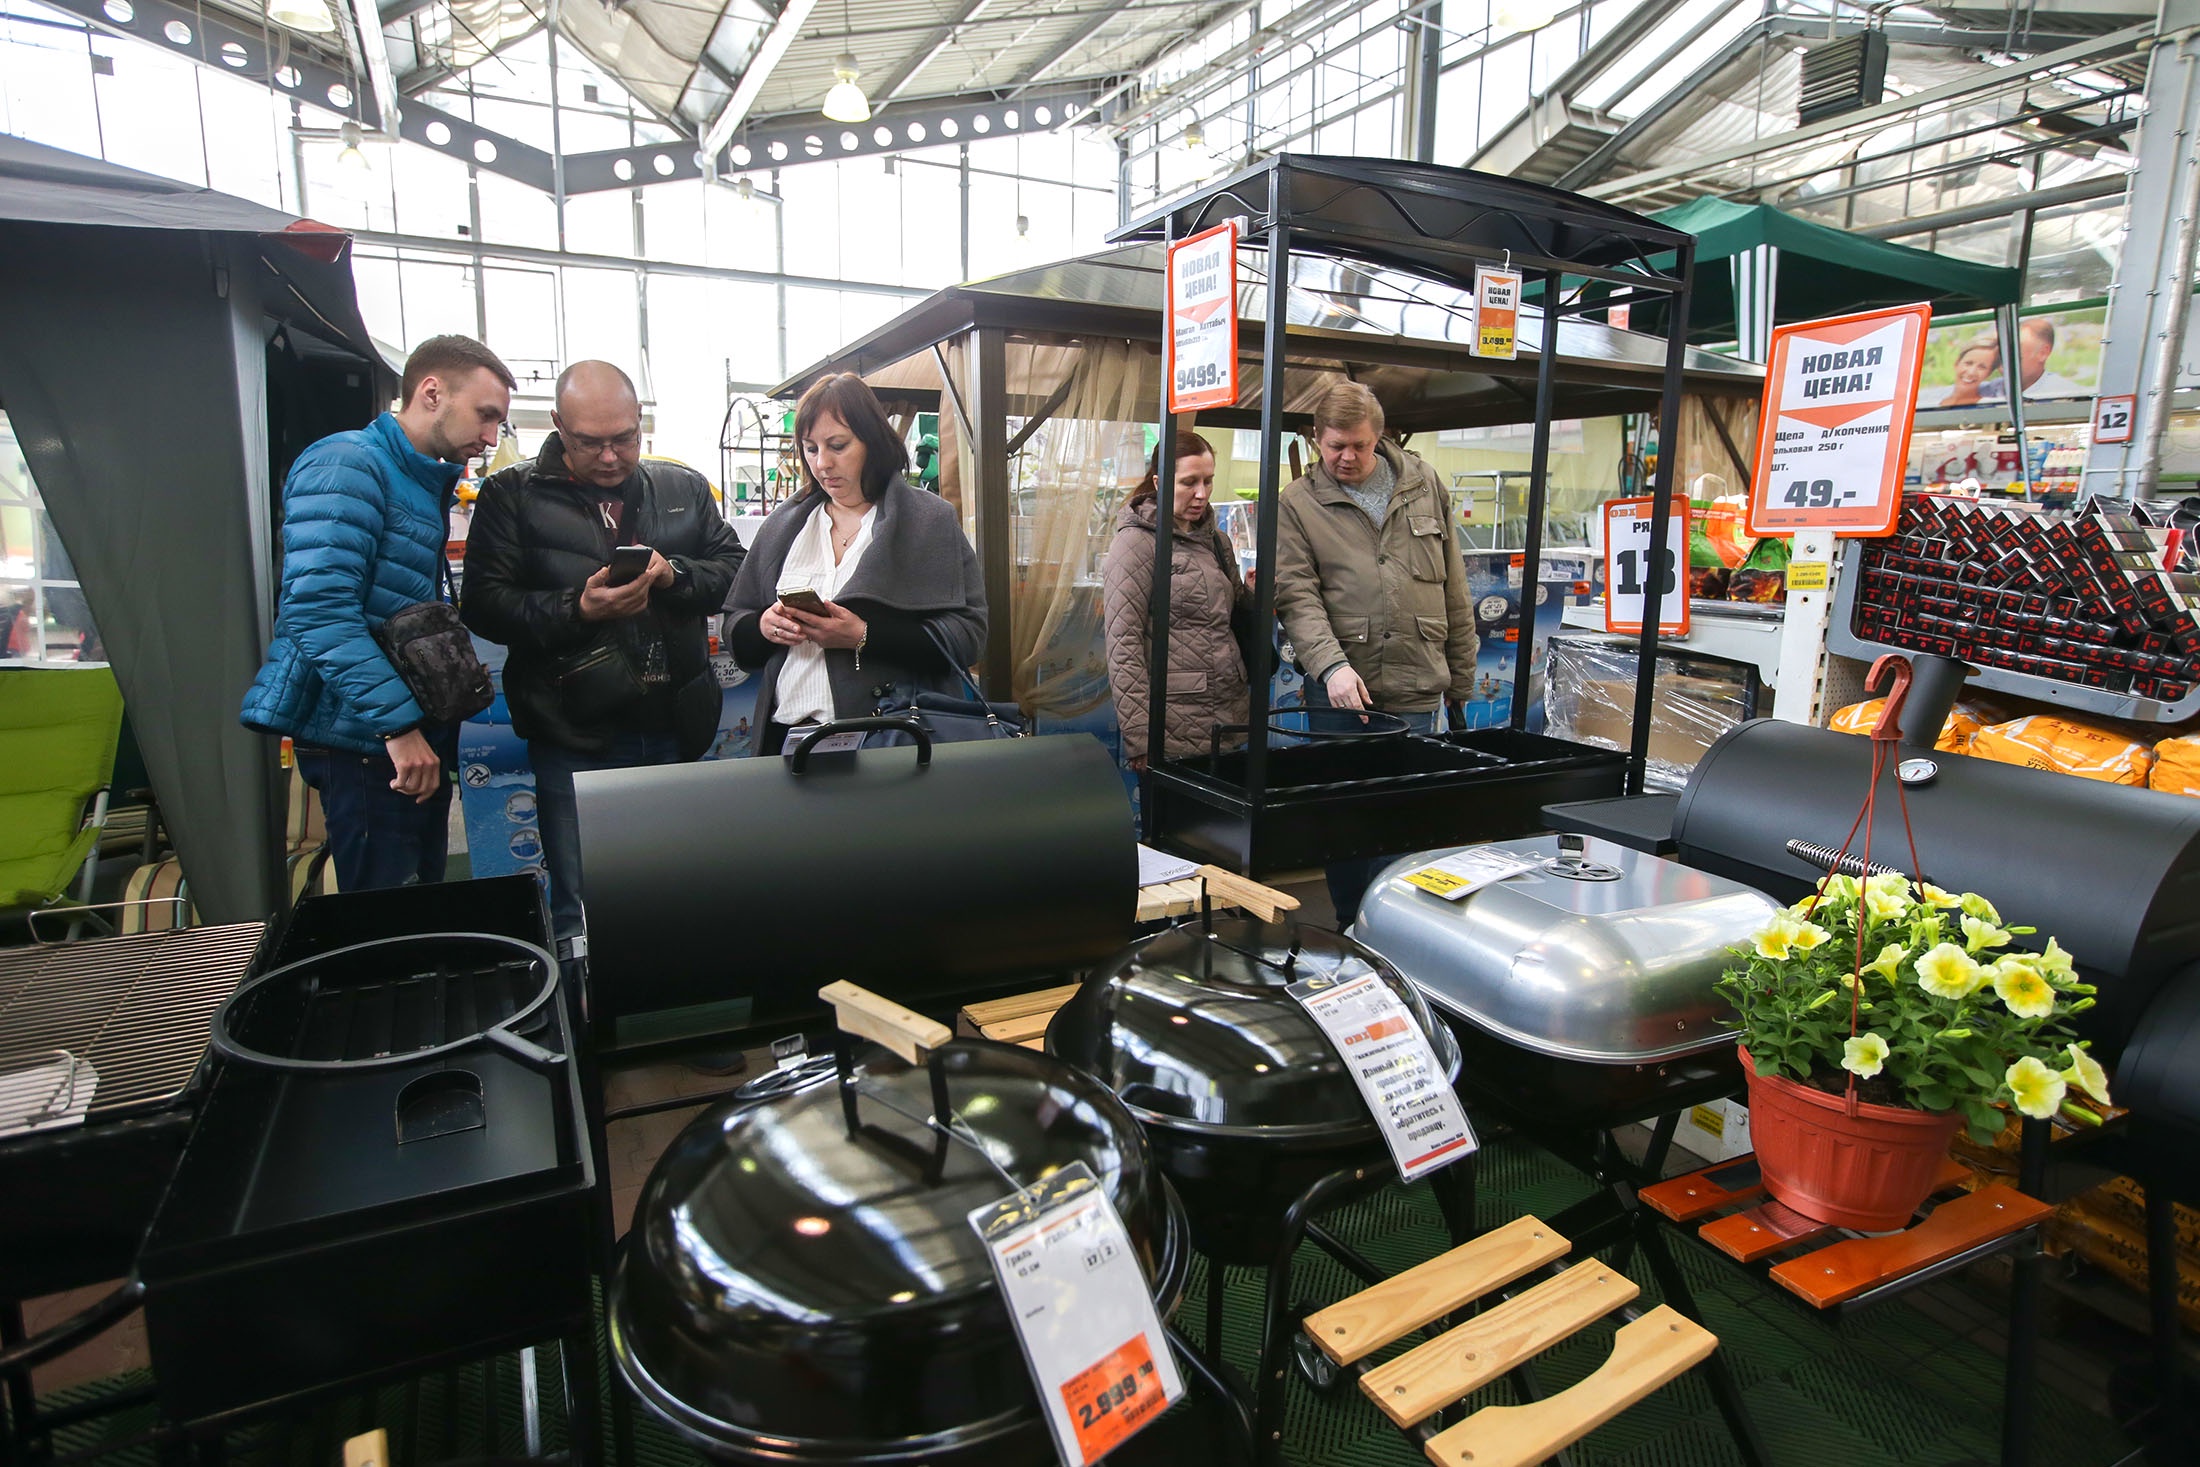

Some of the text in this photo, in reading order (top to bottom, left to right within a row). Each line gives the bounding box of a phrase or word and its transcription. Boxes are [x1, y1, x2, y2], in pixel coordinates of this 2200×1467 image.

[1182, 252, 1219, 278] НОВАЯ
[1185, 278, 1216, 299] ЦЕНА!
[1488, 287, 1510, 296] НОВАЯ
[1490, 297, 1508, 305] ЦЕНА!
[1802, 346, 1883, 374] НОВАЯ
[1803, 373, 1872, 399] ЦЕНА!
[2101, 412, 2127, 429] 12
[1775, 424, 1890, 442] Щепа д/копчения
[1774, 445, 1813, 454] ольховая
[1818, 443, 1836, 451] 250
[1770, 463, 1789, 472] шт.
[1784, 480, 1856, 508] 49,-
[2085, 732, 2112, 743] кг
[1362, 1059, 1395, 1079] Данный
[1396, 1104, 1445, 1129] обратитесь к
[1408, 1121, 1446, 1141] продавцу.
[1087, 1254, 1097, 1266] 17
